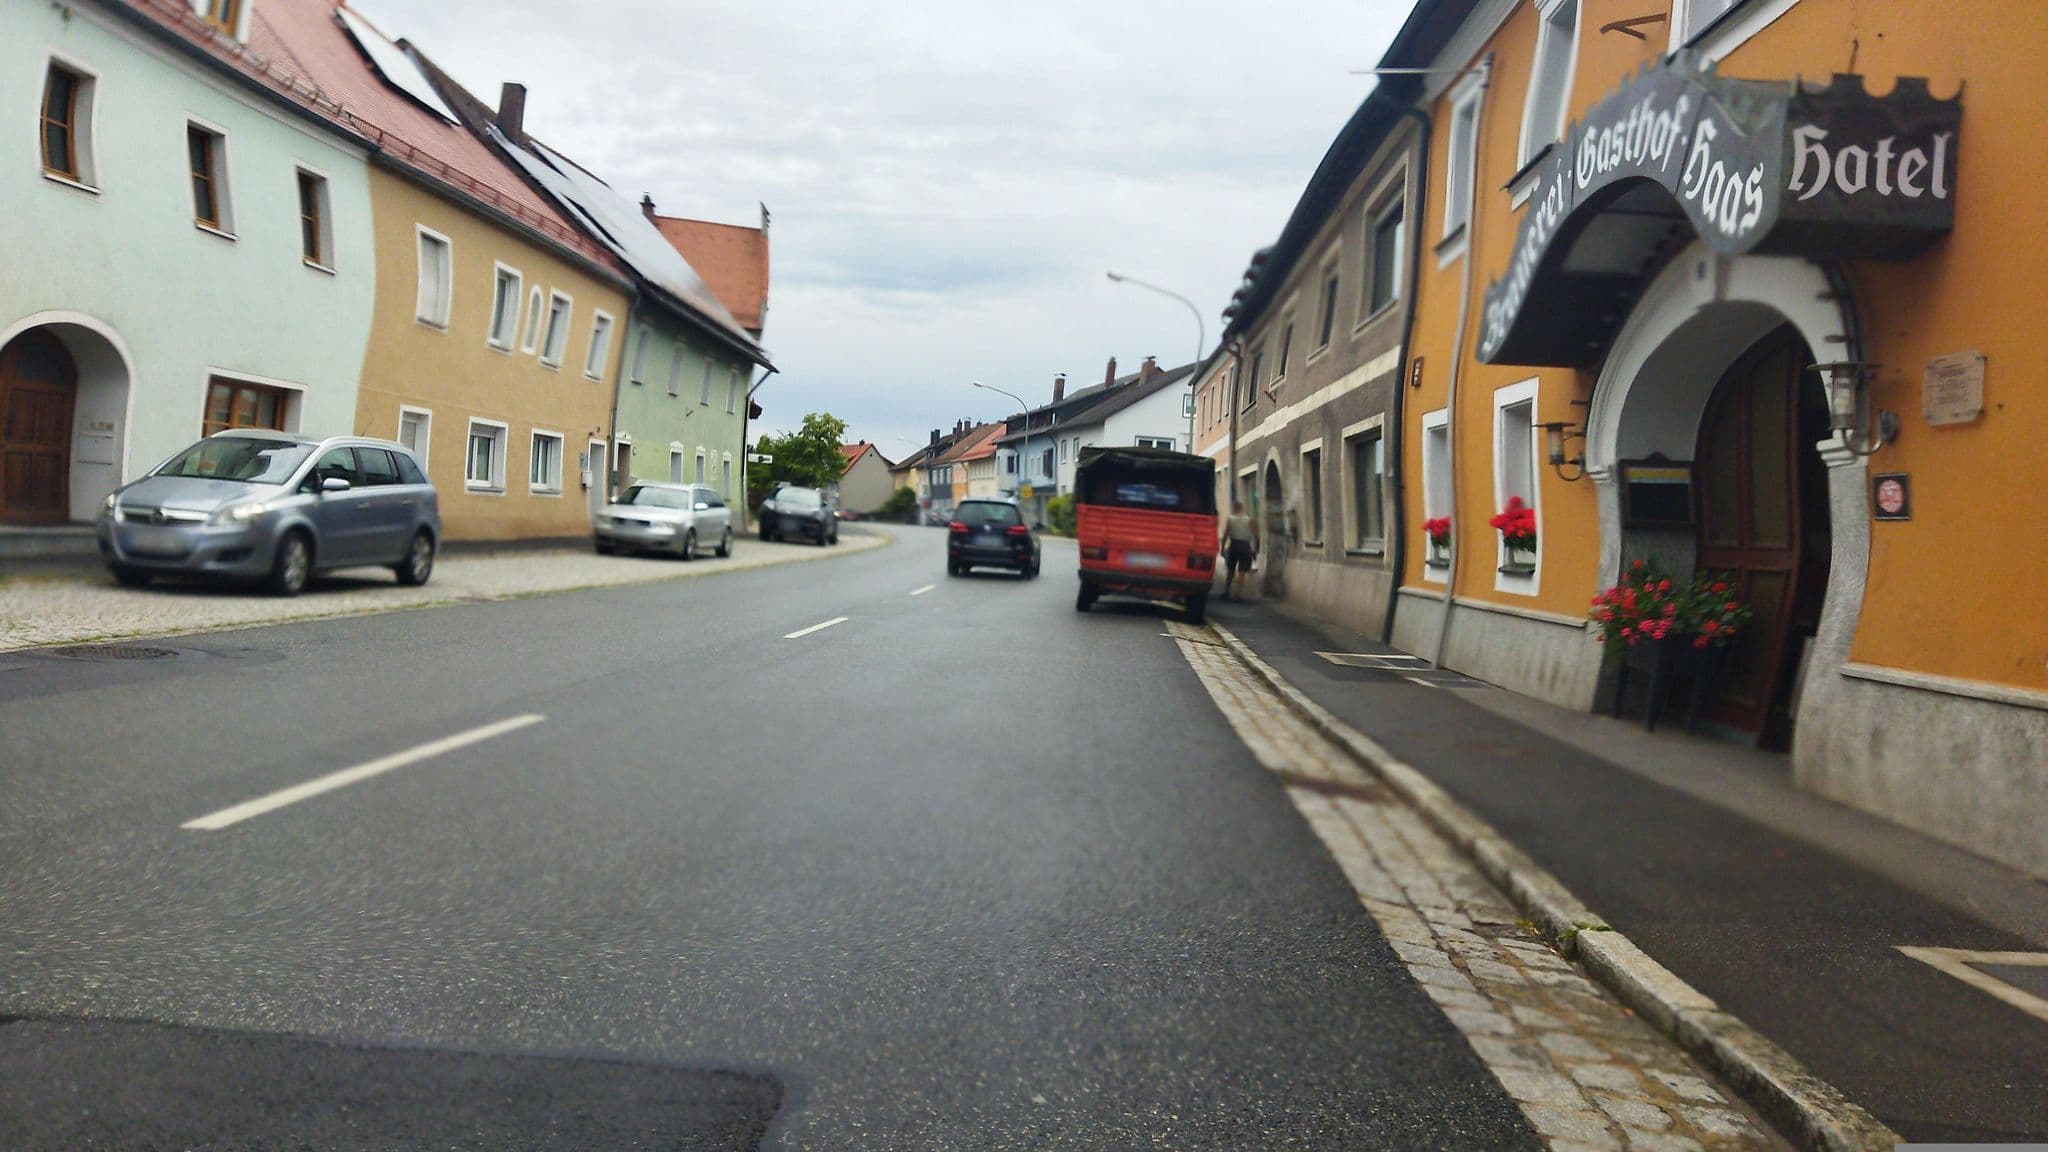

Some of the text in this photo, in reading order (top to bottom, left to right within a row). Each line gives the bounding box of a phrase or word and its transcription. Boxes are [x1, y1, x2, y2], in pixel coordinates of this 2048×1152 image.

[1576, 91, 1689, 190] Gasthof
[1683, 117, 1765, 238] Haas
[1788, 124, 1953, 201] Hotel
